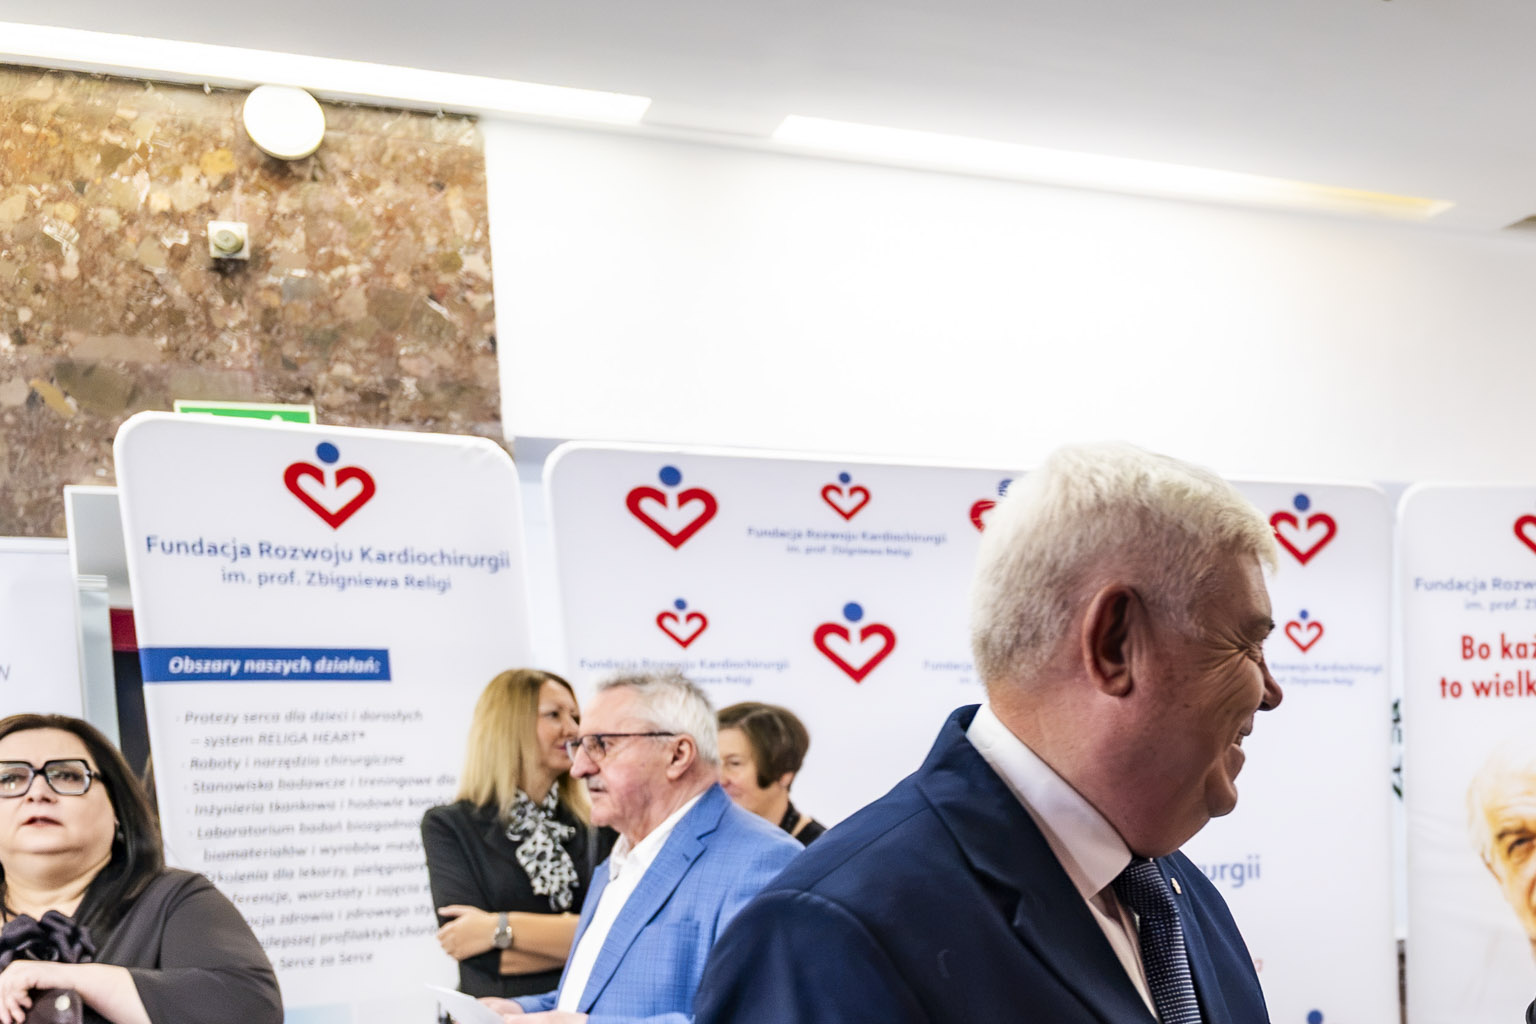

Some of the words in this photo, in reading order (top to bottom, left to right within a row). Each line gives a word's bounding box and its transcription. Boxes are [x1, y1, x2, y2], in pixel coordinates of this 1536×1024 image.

[146, 536, 250, 562] Fundacja
[258, 541, 352, 567] Rozwoju
[361, 547, 510, 573] Kardiochirurgii
[222, 568, 251, 585] im.
[258, 570, 300, 589] prof.
[306, 572, 399, 592] Zbigniewa
[405, 574, 452, 594] Religi
[1414, 577, 1487, 596] Fundacja
[1489, 598, 1518, 613] prof.
[1461, 635, 1491, 660] Bo
[169, 656, 241, 676] Obszary
[244, 656, 311, 676] naszych
[315, 656, 381, 674] działań:
[1440, 676, 1462, 699] to
[203, 734, 253, 748] system
[258, 732, 308, 745] RELIGA
[190, 757, 241, 771] Roboty
